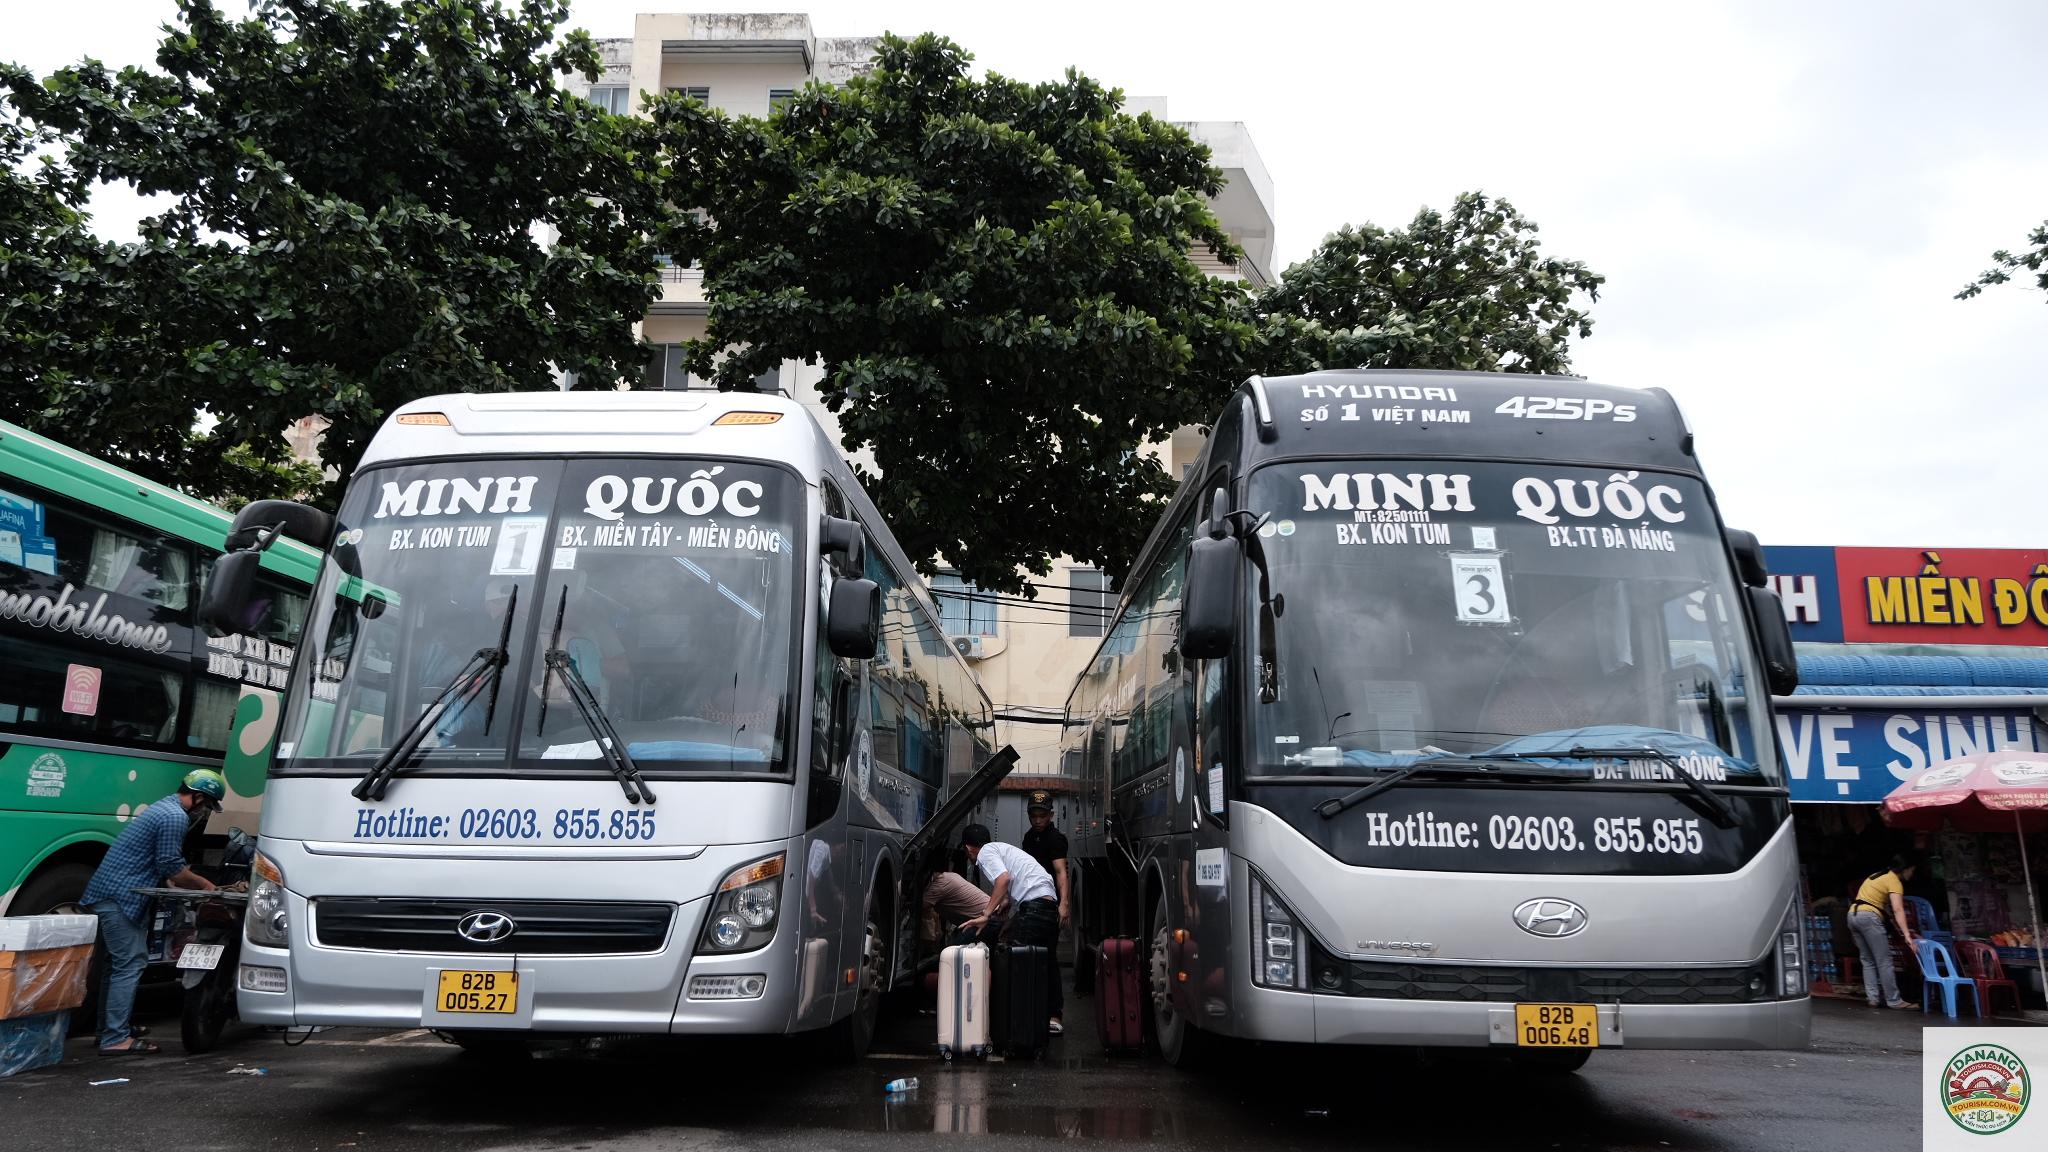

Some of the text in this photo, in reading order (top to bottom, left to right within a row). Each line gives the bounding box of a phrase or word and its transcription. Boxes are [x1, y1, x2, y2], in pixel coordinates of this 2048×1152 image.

[1301, 384, 1457, 402] HYUNDAI
[1300, 404, 1471, 425] SỐ 1 VIỆT NAM
[1495, 395, 1637, 423] 425Ps
[374, 465, 763, 521] MINH QUỐC
[1300, 470, 1686, 524] MINH QUỐC
[1354, 510, 1430, 523] MT:82501111
[389, 526, 491, 551] BX. KON TUM
[561, 526, 589, 547] BX.
[593, 518, 638, 548] MIỀN
[641, 521, 673, 548] TÂY
[687, 518, 730, 549] MIỀN
[734, 523, 781, 553] ĐÔNG
[1336, 523, 1367, 545] BX.
[1370, 523, 1408, 545] KON
[1411, 523, 1451, 546] TUM
[1602, 525, 1627, 551] ĐÀ
[1628, 520, 1676, 552] NẴNG
[502, 530, 528, 569] 1
[1466, 574, 1495, 615] 3
[1865, 551, 1984, 625] MIỀN
[0, 583, 172, 654] mobihome
[354, 808, 656, 841] Hotline: 02603. 855.855
[1367, 812, 1703, 855] Hotline: 02603. 855.855
[1357, 939, 1433, 951] UNIVERSE
[461, 973, 496, 991] 82B
[445, 993, 508, 1011] 005.27
[1538, 1005, 1574, 1025] 82B
[1525, 1026, 1590, 1046] 006.48
